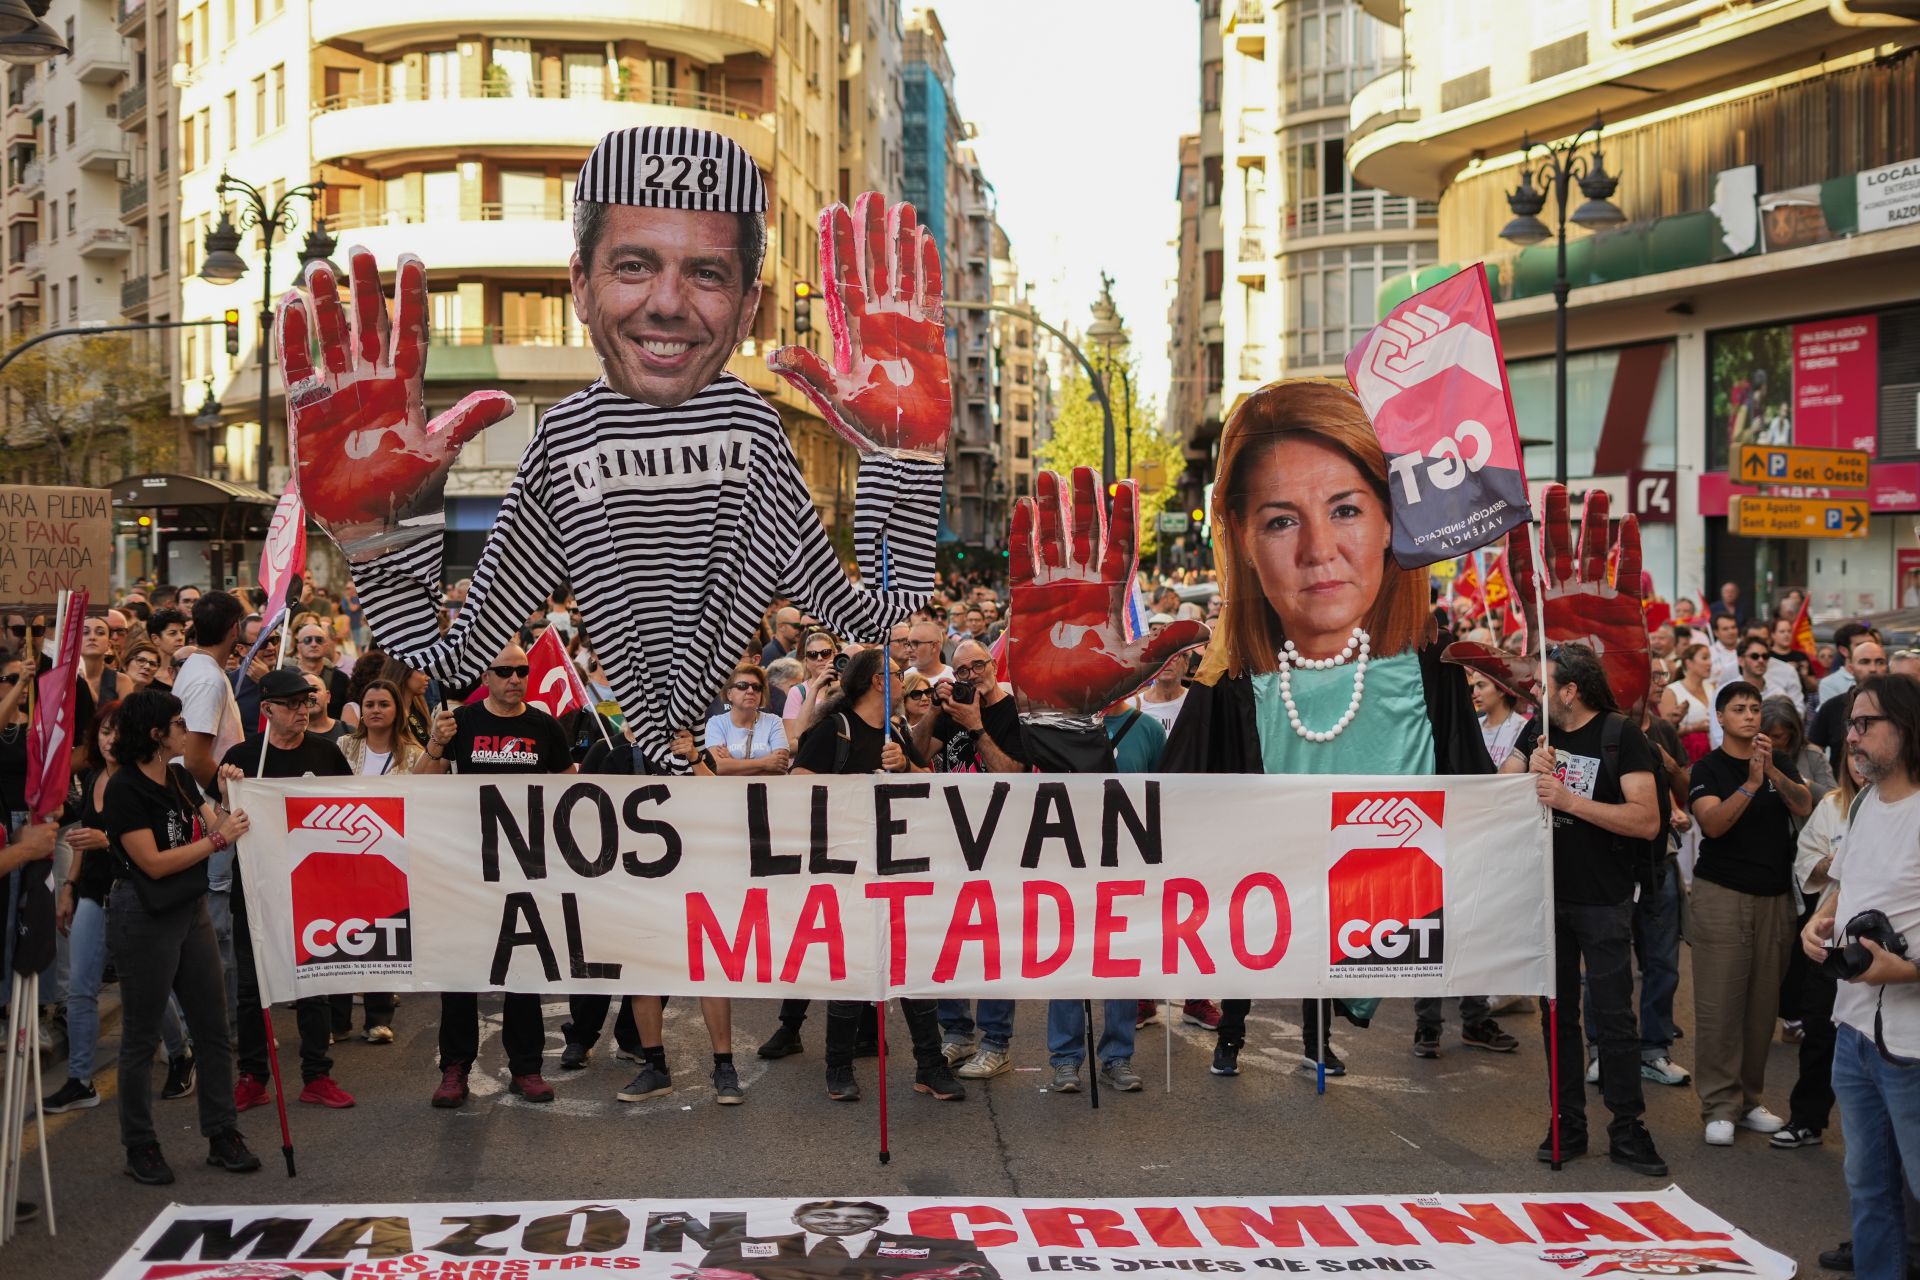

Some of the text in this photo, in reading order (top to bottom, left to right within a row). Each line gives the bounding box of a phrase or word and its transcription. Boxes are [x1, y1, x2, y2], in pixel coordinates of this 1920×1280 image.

[645, 155, 719, 192] 228
[1867, 165, 1920, 186] LOCAL
[1888, 204, 1920, 222] RAZO
[572, 440, 747, 489] CRIMINAL
[1793, 467, 1864, 482] del Oeste
[48, 494, 107, 519] PLENA
[26, 521, 80, 547] FANG
[22, 547, 92, 568] TACADA
[20, 570, 86, 595] SANG
[473, 736, 536, 752] RIOT
[479, 779, 1162, 882] NOS LLEVAN
[302, 918, 407, 958] CGT
[490, 872, 1292, 986] AL MATADERO
[1338, 918, 1440, 958] CGT
[140, 1202, 1734, 1261] MAZÓN CRIMINAL
[353, 1254, 641, 1274] LES NOSTRES
[1027, 1255, 1102, 1272] LES
[1316, 1257, 1436, 1272] SANG
